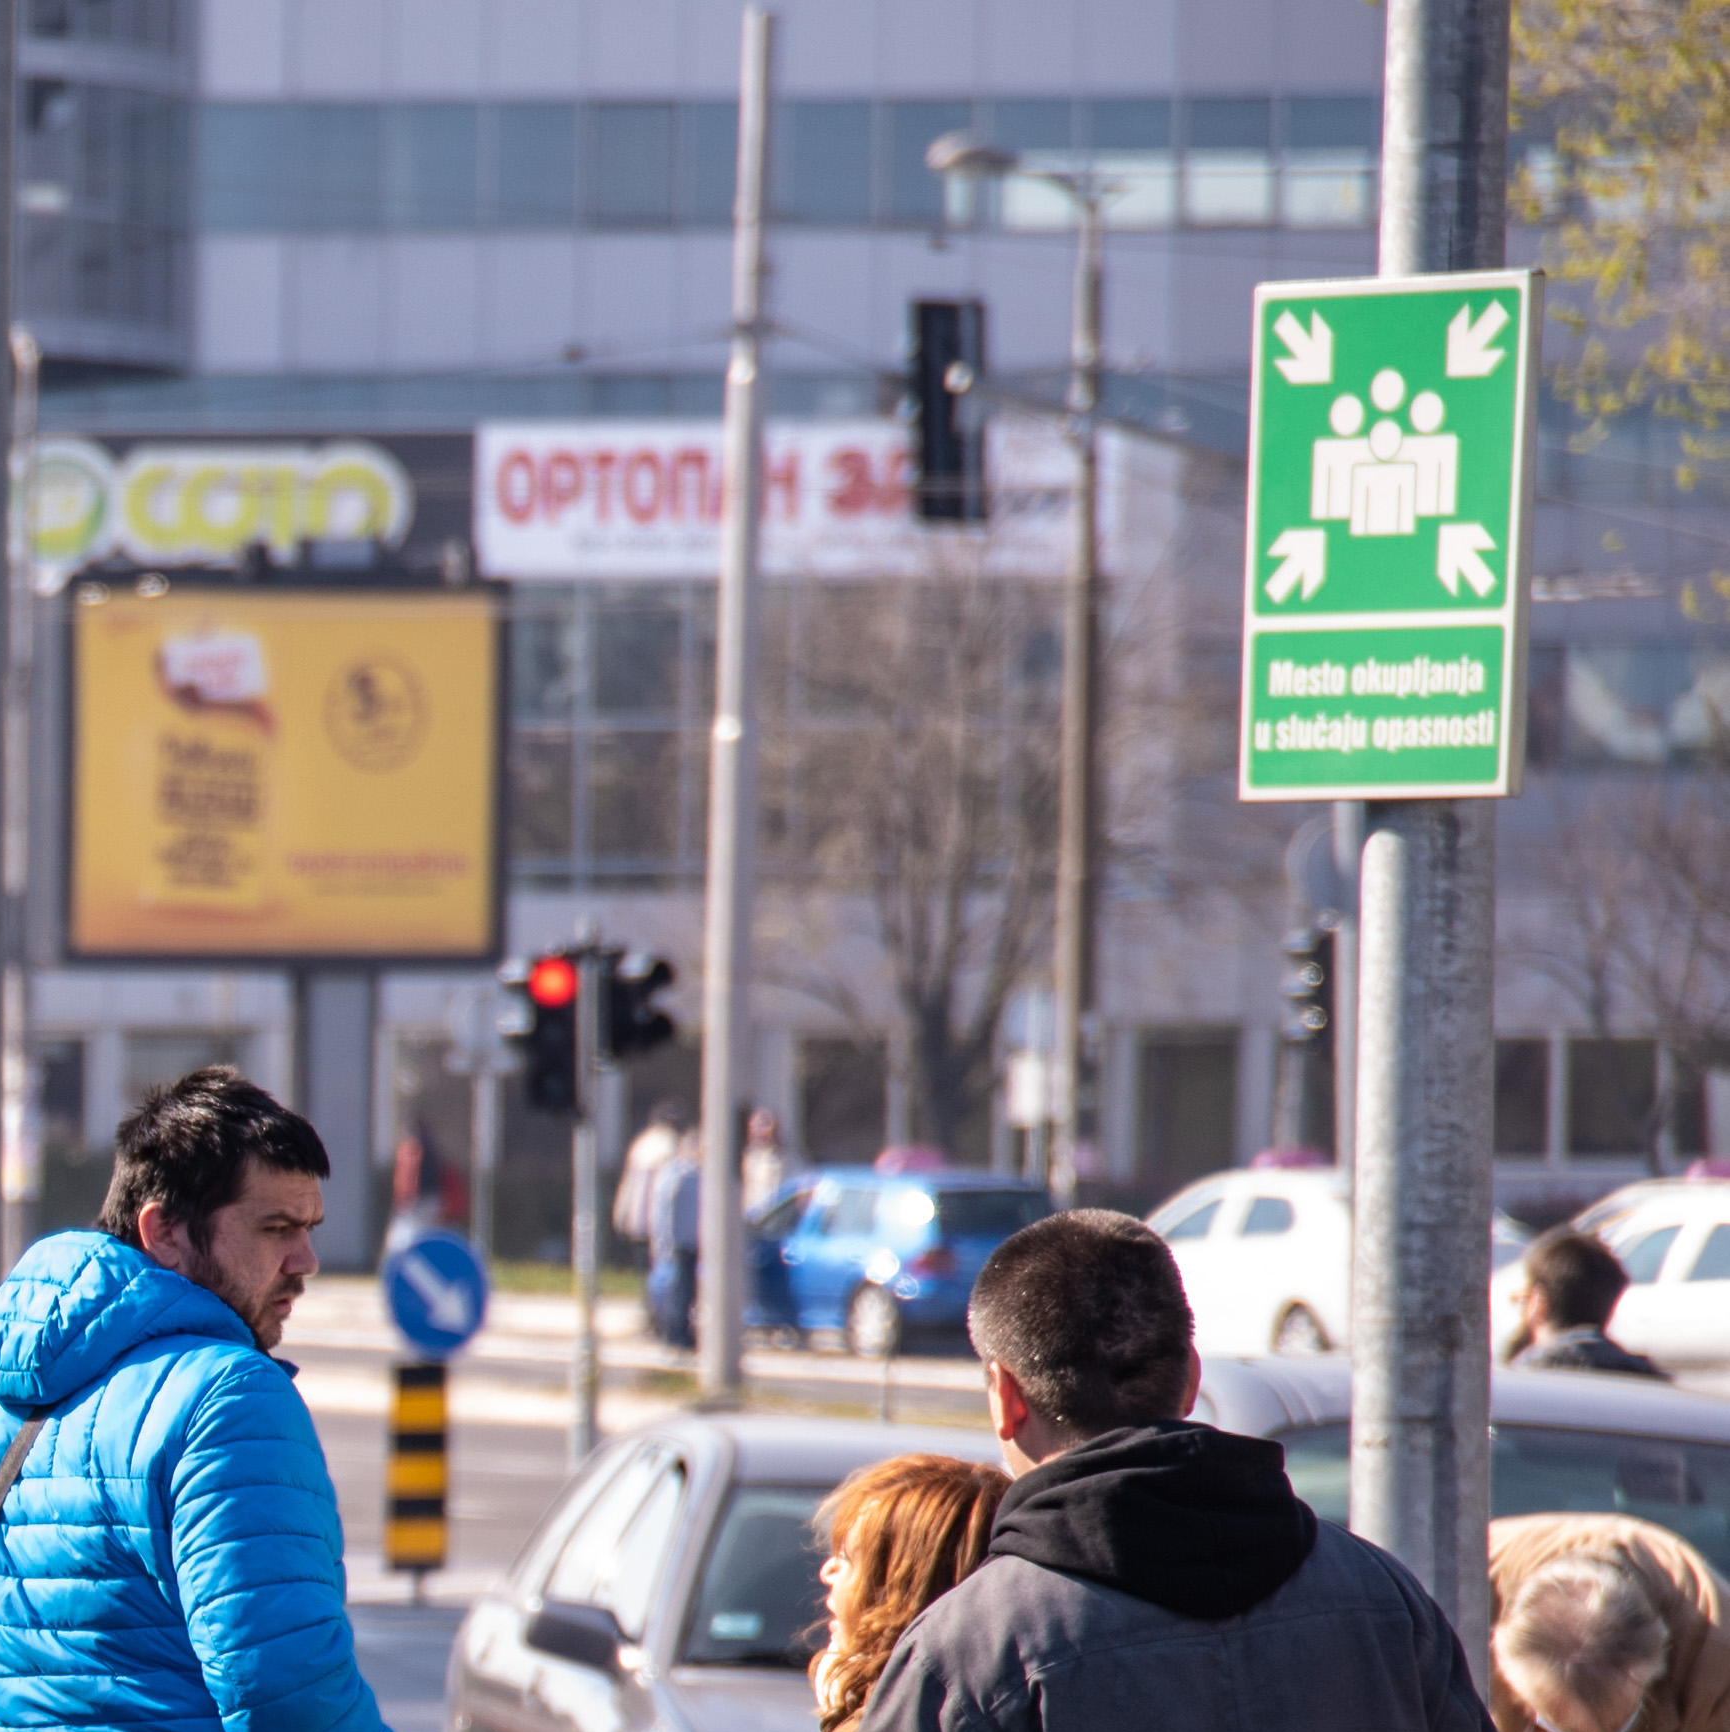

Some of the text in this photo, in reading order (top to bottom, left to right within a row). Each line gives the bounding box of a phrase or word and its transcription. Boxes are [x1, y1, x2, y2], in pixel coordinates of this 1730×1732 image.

[496, 447, 801, 525] ОРТОПН
[1269, 654, 1484, 698] Mesto okupljanja
[1254, 708, 1495, 753] u slučaju opasnosti
